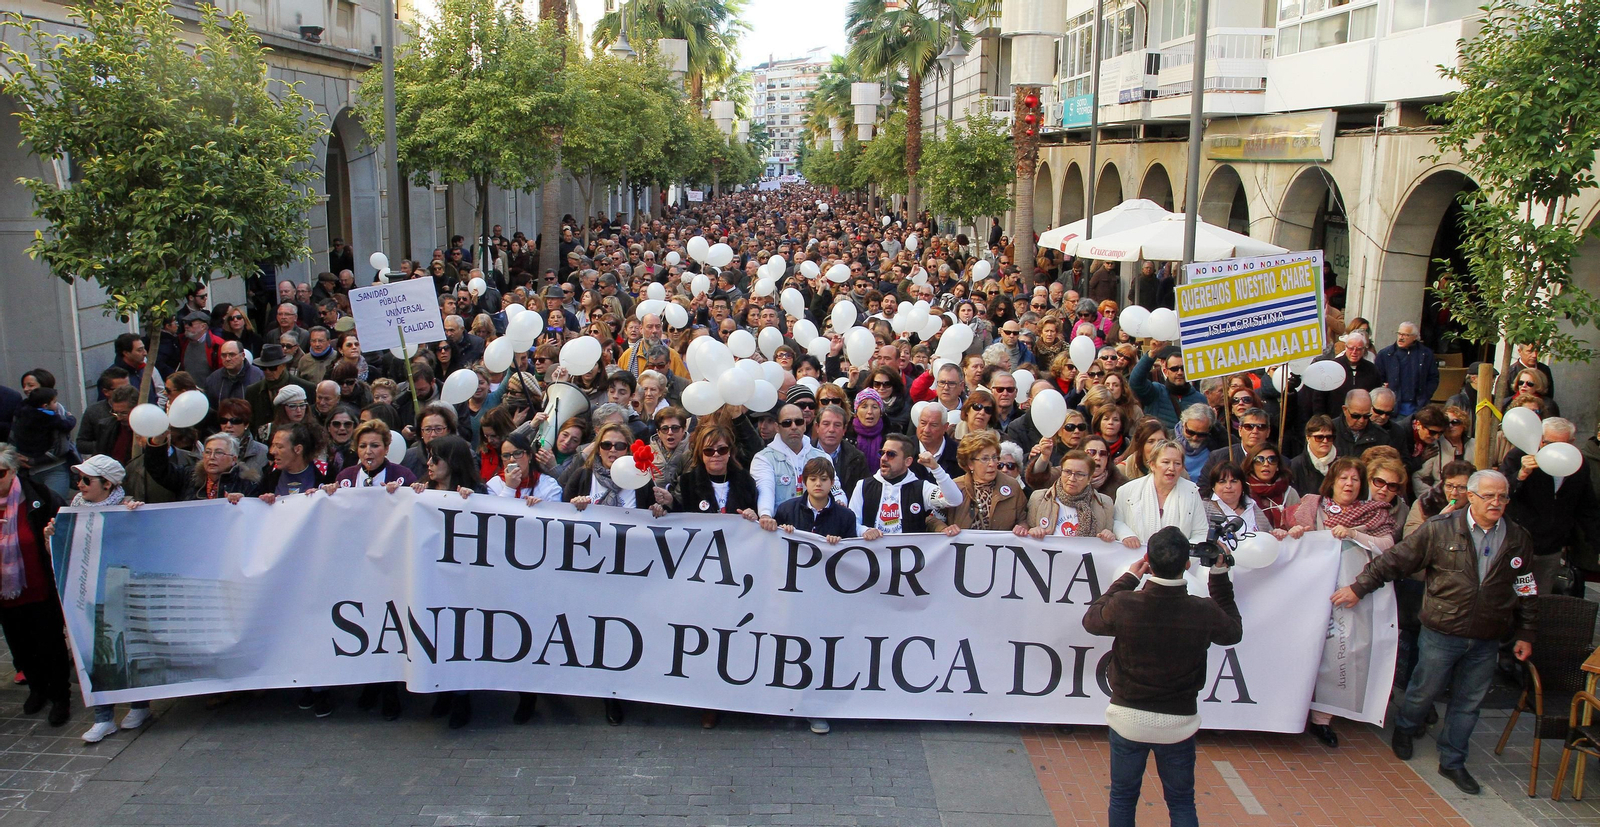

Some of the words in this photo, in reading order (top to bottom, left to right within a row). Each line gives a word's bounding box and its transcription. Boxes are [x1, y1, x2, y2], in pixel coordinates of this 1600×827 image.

[1090, 246, 1127, 259] Cruzcampo
[1195, 267, 1207, 275] NO
[1227, 264, 1239, 272] NO
[1243, 262, 1254, 270] NO
[1260, 260, 1272, 268] NO
[356, 288, 389, 302] SANIDAD
[380, 294, 407, 306] PÚBLICA
[1181, 280, 1231, 312] QUEREMOS
[1234, 271, 1276, 301] NUESTRO
[385, 304, 425, 317] UNIVERSAL
[397, 317, 405, 325] DE
[403, 320, 434, 333] CALIDAD
[1207, 323, 1233, 336] ISLA
[1235, 311, 1286, 330] CRISTINA
[81, 533, 92, 567] Infanta
[437, 507, 754, 598] HUELVA,
[778, 537, 930, 597] POR
[950, 543, 1101, 605] UNA
[76, 566, 89, 611] Hospital
[331, 600, 644, 671] SANIDAD
[664, 612, 988, 693] PÚBLICA
[1337, 663, 1347, 690] Juan
